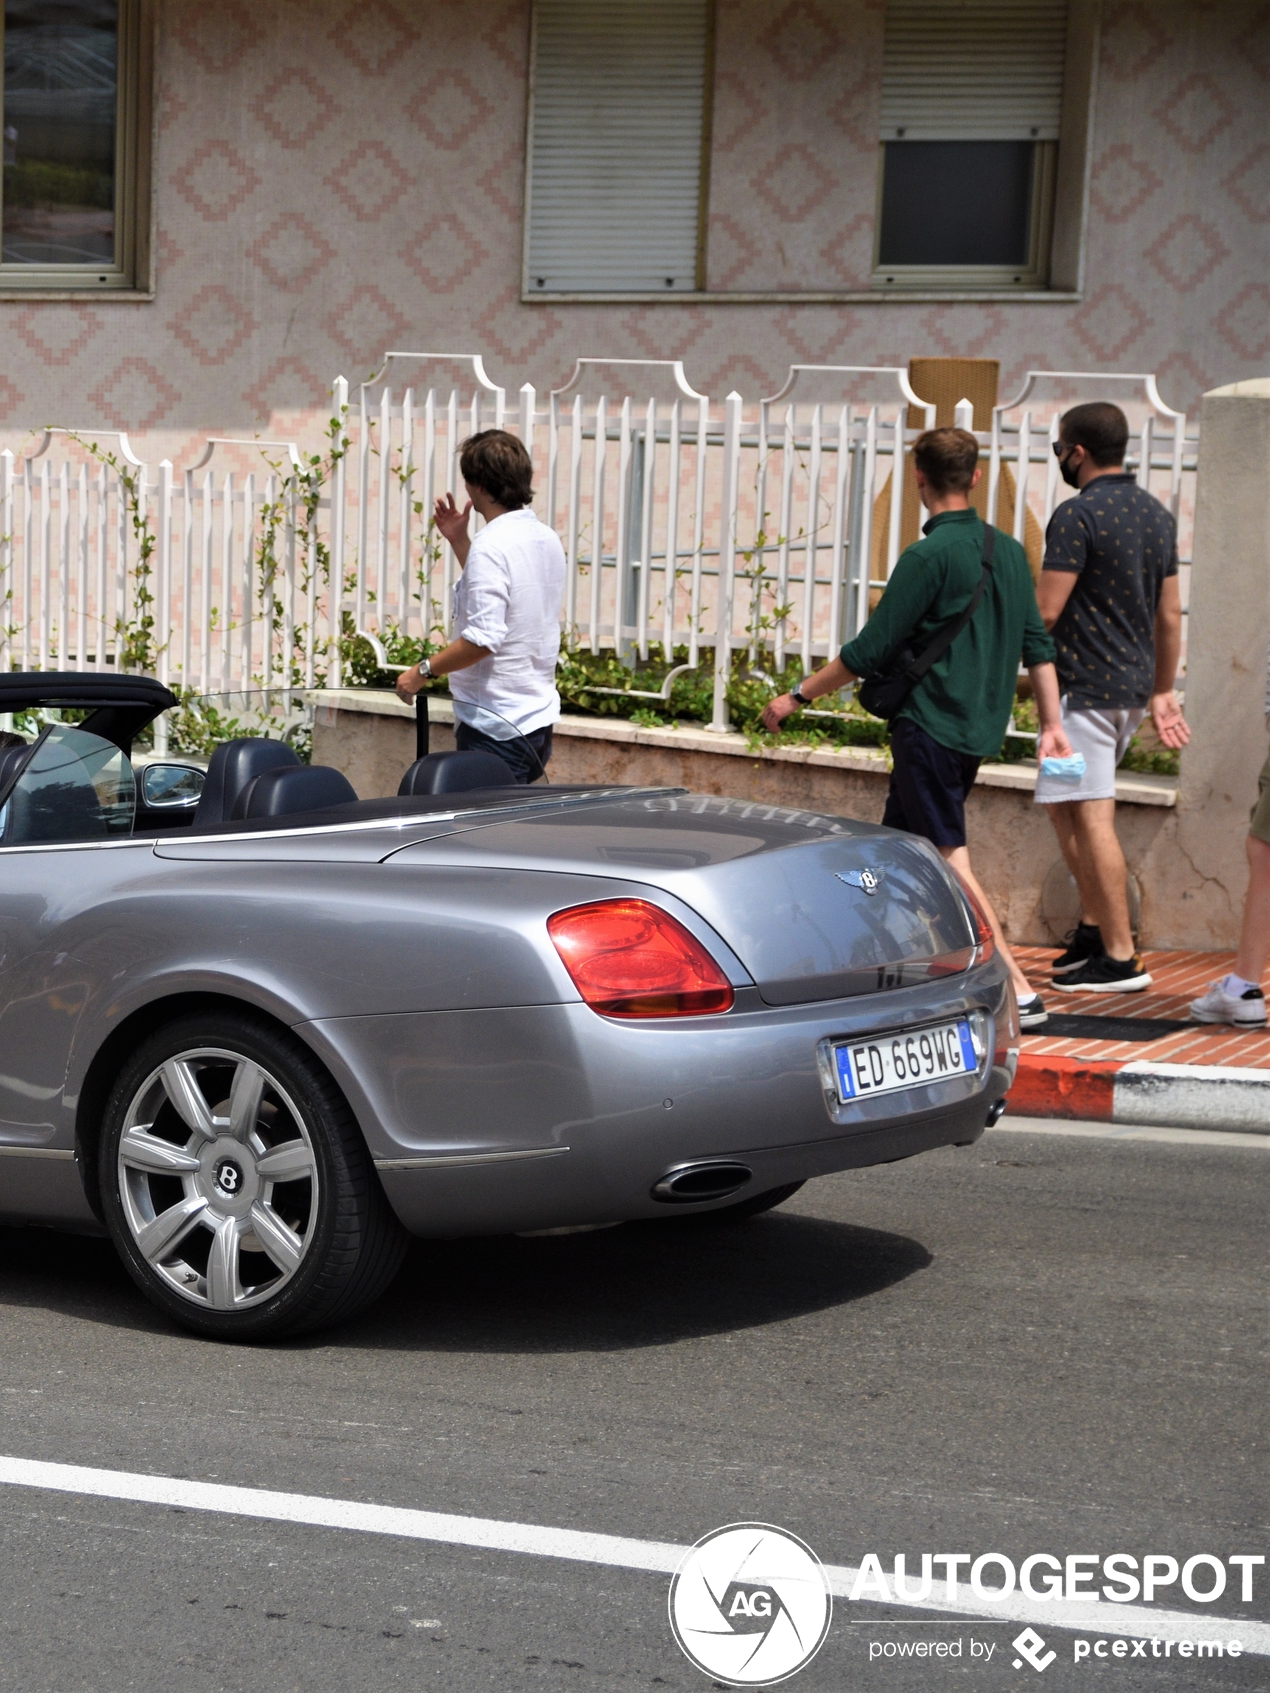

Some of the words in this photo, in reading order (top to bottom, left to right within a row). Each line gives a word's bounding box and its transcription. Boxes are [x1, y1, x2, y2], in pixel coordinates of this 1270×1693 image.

[852, 1045, 884, 1090] ED
[891, 1028, 961, 1080] 669WG
[219, 1166, 237, 1189] B
